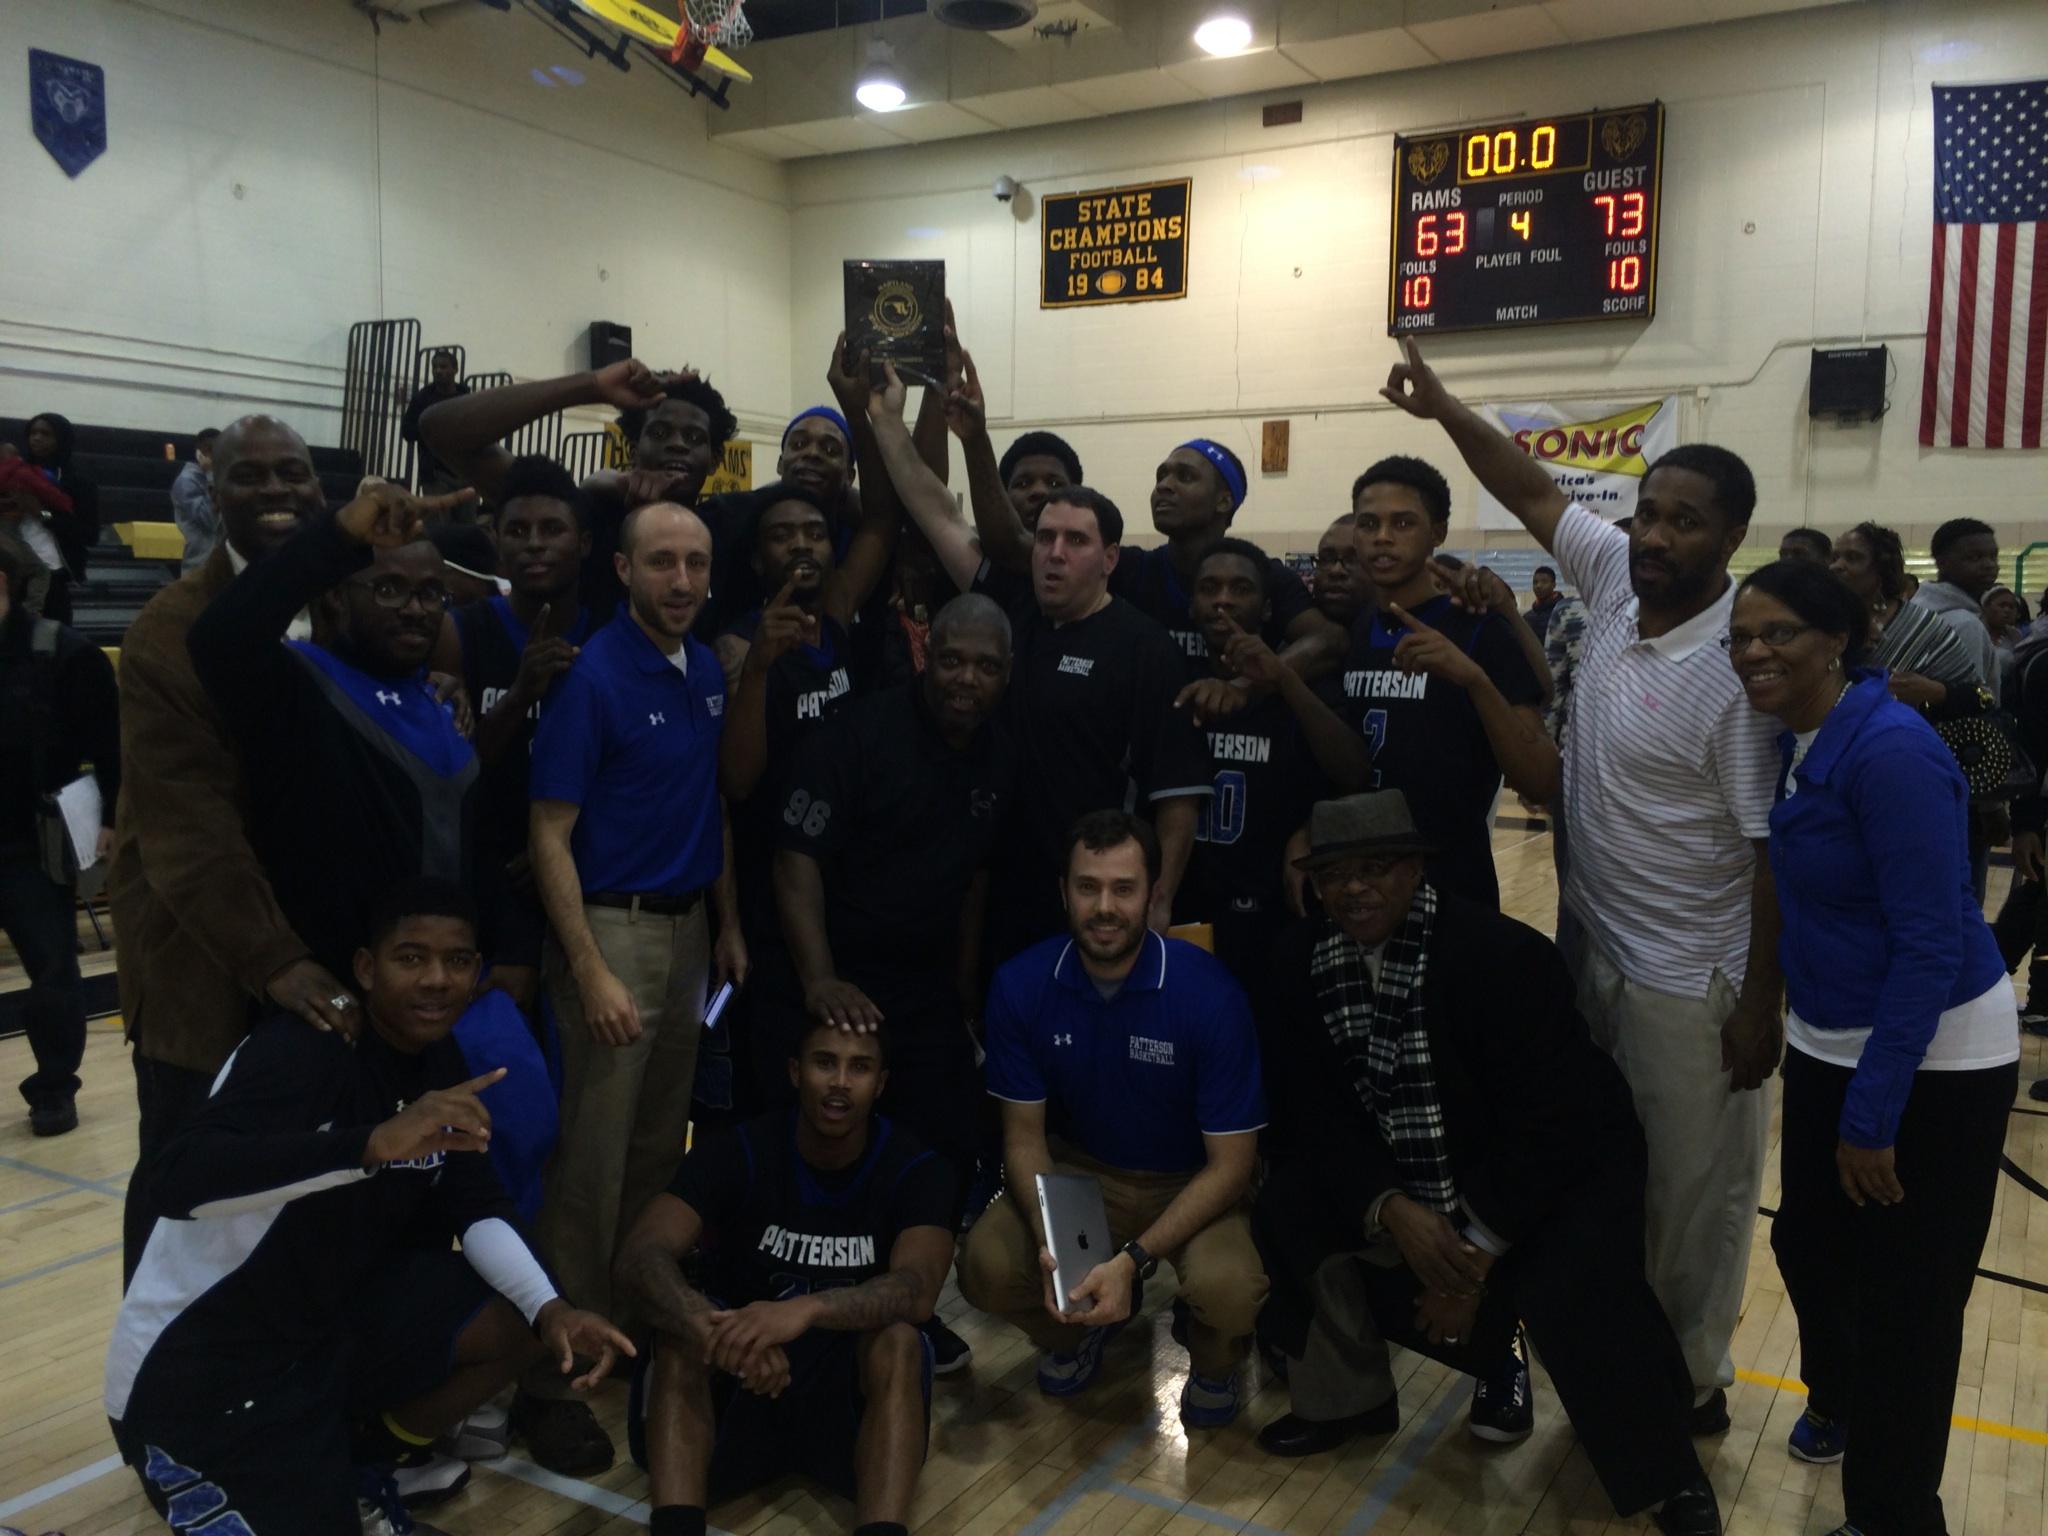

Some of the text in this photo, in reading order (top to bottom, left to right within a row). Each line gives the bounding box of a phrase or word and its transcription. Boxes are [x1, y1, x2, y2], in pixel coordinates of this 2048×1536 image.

[1466, 126, 1556, 177] 00.0
[1583, 166, 1647, 192] GUEST
[1078, 192, 1152, 223] STATE
[1411, 187, 1462, 212] RAMS
[1499, 189, 1544, 207] PERIOD
[1510, 210, 1530, 240] 4
[1594, 192, 1643, 236] 73
[1050, 215, 1182, 252] CHAMPIONS
[1417, 212, 1465, 256] 63
[1605, 239, 1647, 257] FOULS
[1070, 245, 1158, 270] FOOTBALL
[1400, 259, 1437, 276] FOULS
[1475, 248, 1562, 269] PLAYER FOUL
[1067, 267, 1163, 297] 19 84
[1610, 256, 1639, 290] 10
[1405, 275, 1431, 307] 10
[1602, 295, 1646, 313] SCORE
[1397, 312, 1436, 329] SCORE
[1496, 304, 1538, 321] MATCH
[1512, 423, 1646, 461] SONIC
[1554, 473, 1595, 486] rica's
[784, 788, 832, 837] 96
[758, 1224, 876, 1267] PATTERSON
